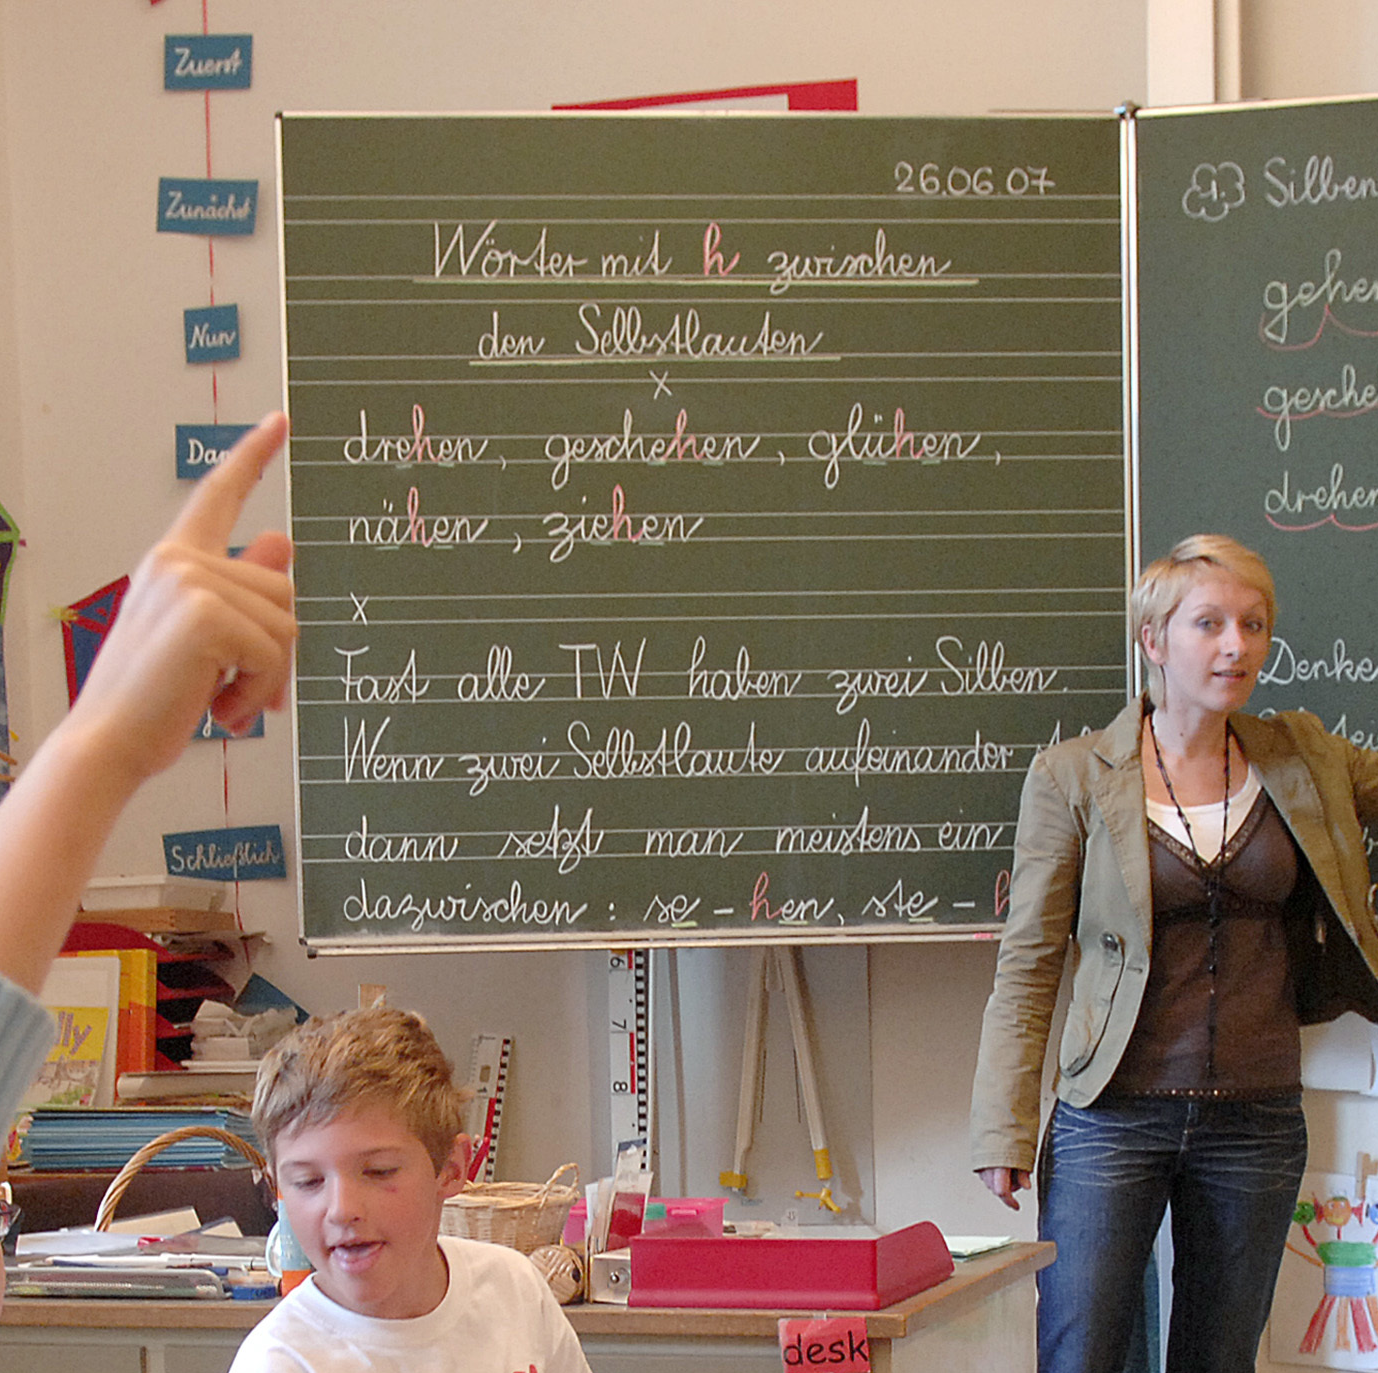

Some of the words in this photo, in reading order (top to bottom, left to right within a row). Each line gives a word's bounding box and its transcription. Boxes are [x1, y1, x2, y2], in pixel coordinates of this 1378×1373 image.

[175, 47, 242, 76] Zuerst
[164, 191, 251, 221] Zunächst
[433, 219, 588, 279] Wörter
[601, 230, 672, 278] mit
[702, 222, 740, 278] h
[767, 229, 952, 295] zwischen
[190, 324, 237, 348] Nun
[478, 311, 546, 361] den
[575, 302, 824, 359] Selbstlauten
[543, 484, 704, 564] ziehen
[335, 645, 430, 704] Fast
[458, 646, 546, 702] alle
[559, 638, 647, 700] TW
[686, 636, 802, 698] haben
[826, 656, 930, 714] zwei
[934, 636, 1067, 695] Silben.
[344, 718, 445, 785] Wenn
[459, 738, 562, 796] zwei
[567, 720, 784, 782] Selbstlaute
[805, 718, 1014, 788] aufeinander
[343, 816, 460, 863] dann
[496, 805, 605, 875] setzt
[644, 828, 744, 859] man
[775, 806, 922, 856] meistens
[938, 804, 1004, 853] ein
[783, 1330, 870, 1366] desk
